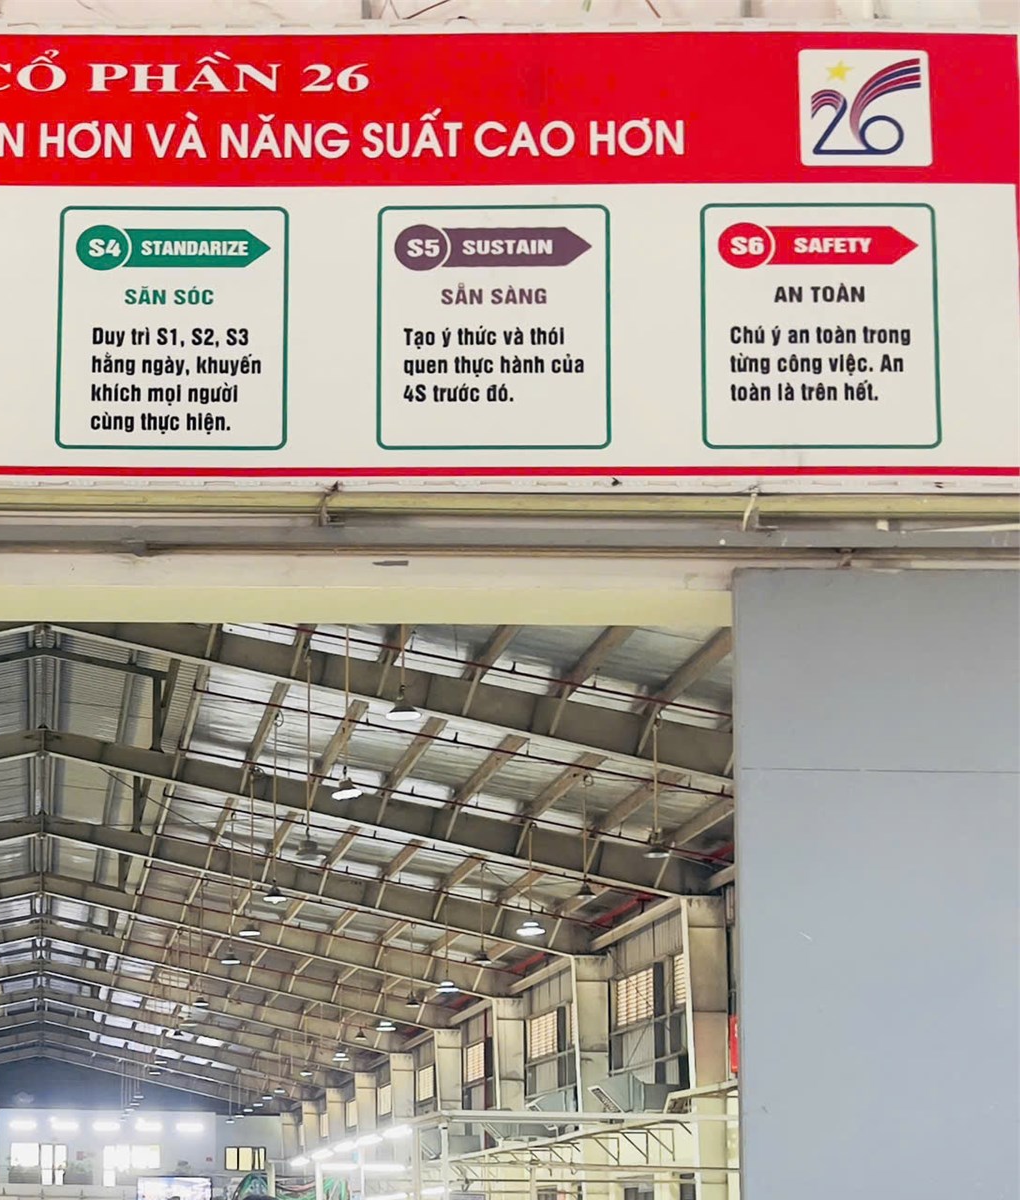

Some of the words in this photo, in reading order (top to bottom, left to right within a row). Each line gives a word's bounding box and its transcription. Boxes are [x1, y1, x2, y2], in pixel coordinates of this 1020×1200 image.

[88, 50, 282, 93] PHẦN
[302, 63, 370, 93] 26
[38, 119, 132, 159] HƠN
[146, 111, 212, 159] VÀ
[220, 113, 349, 159] NĂNG
[362, 108, 464, 158] SUẤT
[474, 120, 576, 157] CAO
[588, 119, 685, 156] HƠN
[89, 239, 122, 257] S4
[141, 240, 249, 256] STANDARIZE
[407, 239, 440, 257] S5
[462, 239, 552, 255] SUSTAIN
[730, 236, 765, 255] S6
[794, 237, 872, 254] SAFETY
[124, 286, 166, 305] SĂN
[174, 286, 214, 305] SÓC
[491, 285, 547, 304] SÀNG
[774, 286, 803, 302] AN
[811, 283, 865, 302] TOÀN
[92, 327, 125, 347] Duy
[132, 327, 150, 345] trì
[157, 328, 185, 347] S1,
[192, 328, 220, 347] S2,
[226, 328, 249, 346] S3
[404, 328, 435, 349] Tạo
[442, 328, 451, 347] ý
[458, 326, 496, 345] thức
[504, 327, 523, 345] và
[530, 327, 564, 345] thói
[730, 326, 765, 344] Chú
[772, 326, 781, 346] ý
[788, 329, 809, 343] an
[816, 326, 856, 344] toàn
[863, 326, 911, 345] trong
[92, 352, 135, 375] hằng
[142, 356, 190, 376] ngày,
[197, 354, 261, 376] khuyến
[404, 358, 448, 376] quen
[454, 356, 493, 377] thực
[500, 355, 544, 373] hành
[551, 354, 585, 373] của
[730, 353, 770, 374] từng
[777, 354, 822, 374] công
[829, 354, 873, 376] việc.
[880, 354, 904, 372] An
[91, 384, 141, 402] khích
[148, 384, 180, 406] mọi
[188, 383, 238, 405] người
[403, 384, 426, 402] 4S
[433, 383, 480, 402] trước
[487, 384, 514, 402] đó.
[731, 383, 771, 401] toàn
[778, 383, 794, 401] là
[802, 382, 837, 401] trên
[845, 380, 879, 401] hết.
[91, 412, 134, 432] cùng
[141, 413, 179, 434] thực
[186, 413, 231, 434] hiện.
